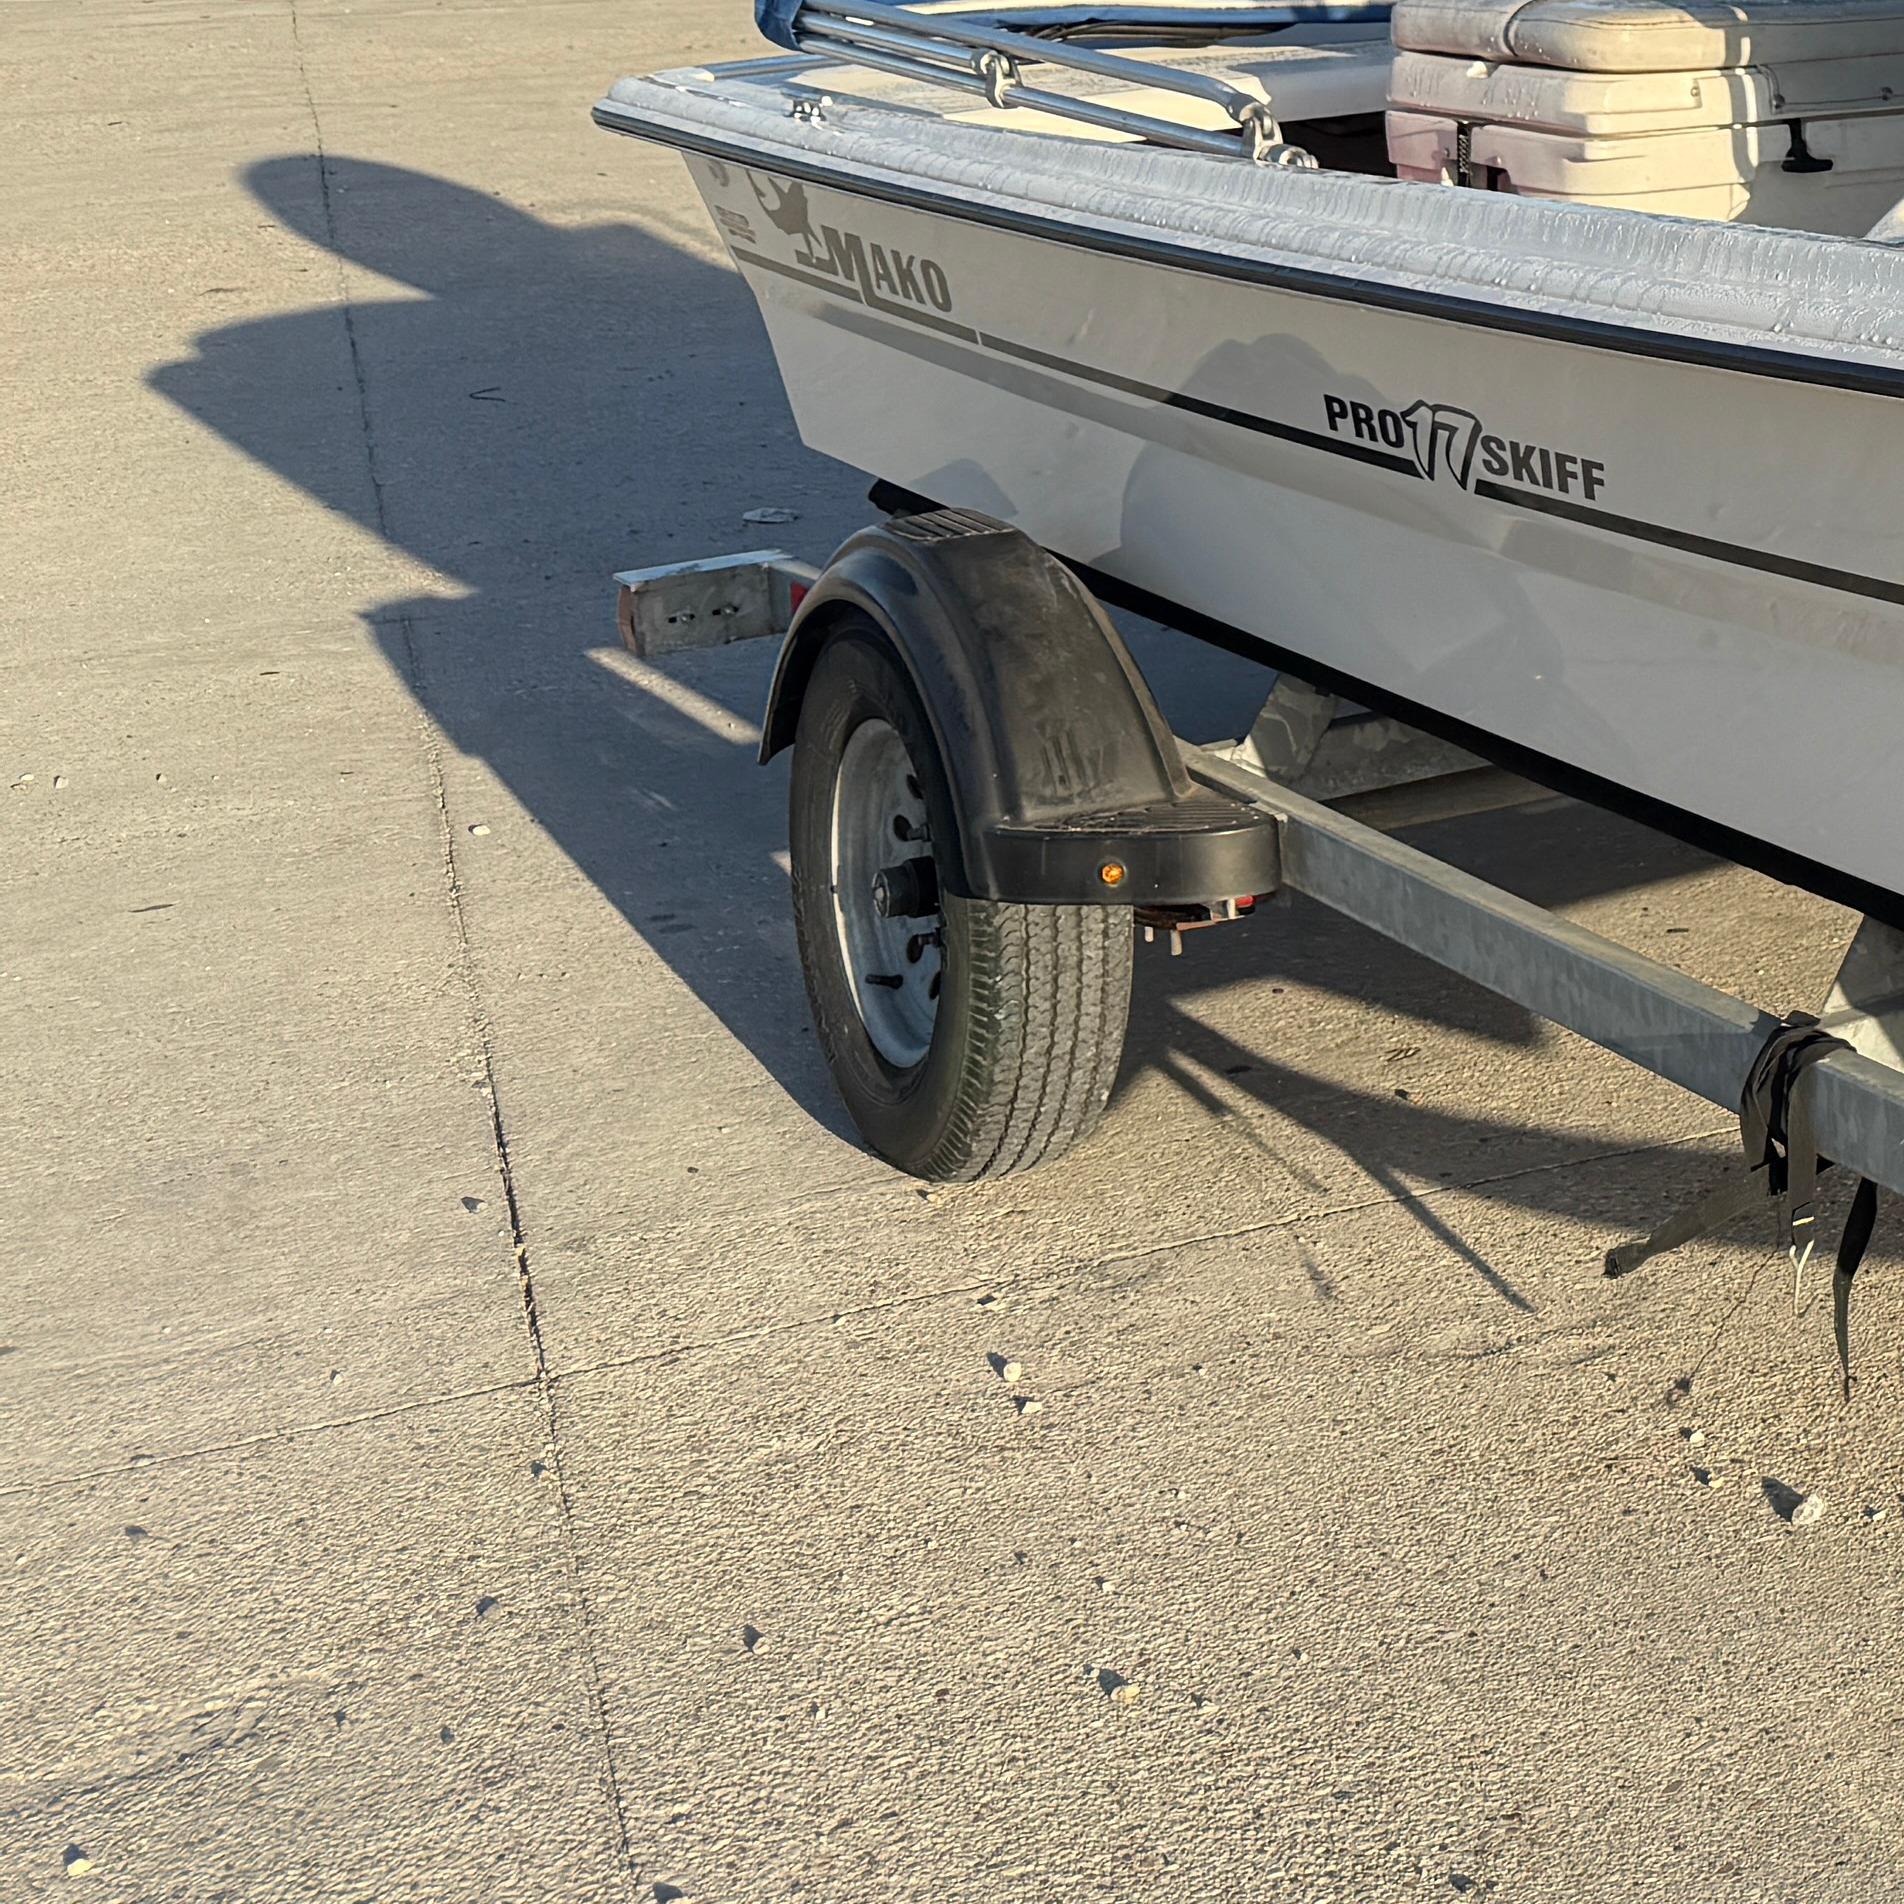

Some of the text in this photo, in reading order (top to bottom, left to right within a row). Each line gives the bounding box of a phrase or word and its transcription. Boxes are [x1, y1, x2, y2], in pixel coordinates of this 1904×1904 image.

[795, 225, 957, 320] MAKO
[1323, 394, 1605, 501] PRO 17 SKIFF
